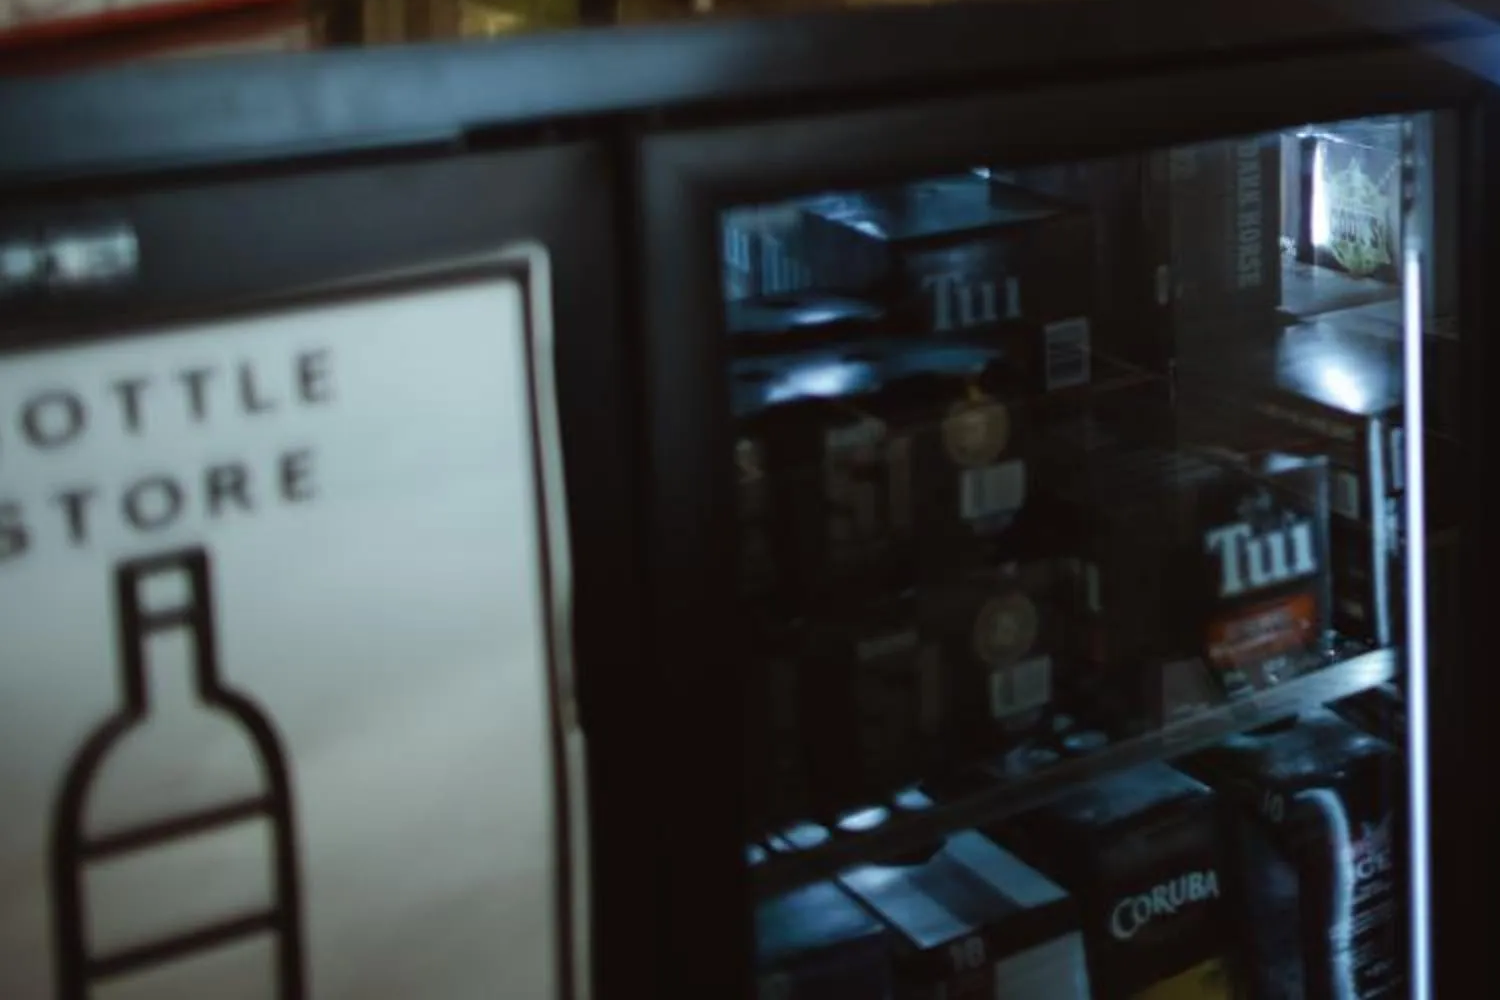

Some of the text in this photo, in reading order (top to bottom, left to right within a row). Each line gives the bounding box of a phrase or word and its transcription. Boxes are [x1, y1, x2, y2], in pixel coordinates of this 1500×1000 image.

[919, 270, 1022, 333] Tui
[0, 346, 336, 452] OTTLE
[0, 448, 323, 563] STORE
[1204, 514, 1319, 597] Tui
[1109, 867, 1221, 940] CORUBA
